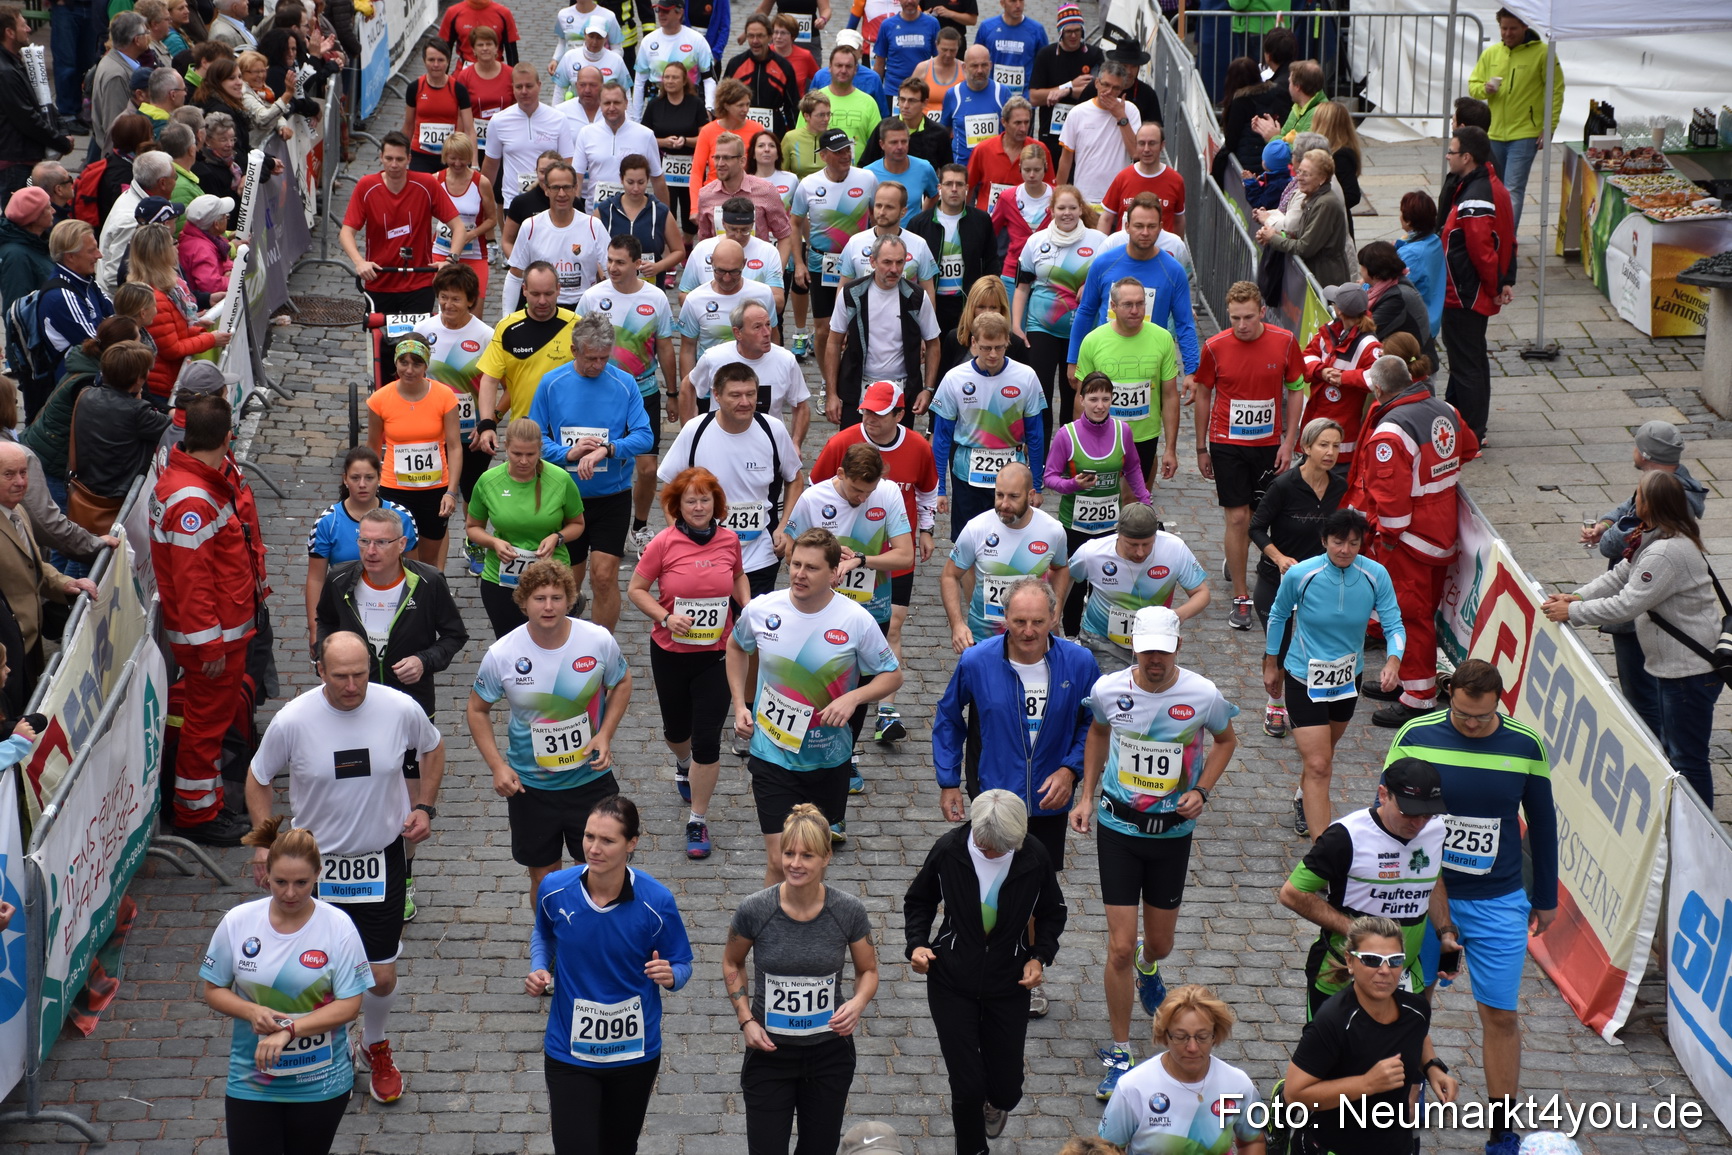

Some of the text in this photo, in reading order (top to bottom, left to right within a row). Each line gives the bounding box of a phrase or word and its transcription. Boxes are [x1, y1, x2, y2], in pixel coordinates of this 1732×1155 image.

[896, 34, 924, 43] HUBER
[995, 39, 1024, 49] HUBER
[996, 72, 1022, 86] 2318
[972, 122, 994, 135] 380
[665, 162, 692, 175] 2562
[237, 162, 257, 232] BMW Laufsport
[463, 342, 478, 350] Hervis
[512, 346, 534, 354] Robert
[1003, 388, 1019, 396] Hervis
[1110, 389, 1146, 407] 2341
[1115, 409, 1143, 417] Wolfgang
[1234, 409, 1272, 425] 2049
[1241, 427, 1264, 435] Bastian
[404, 453, 433, 471] 164
[407, 473, 432, 482] Claudia
[867, 510, 885, 518] Hervis
[1079, 504, 1116, 521] 2295
[1031, 543, 1048, 552] Hervis
[1150, 568, 1168, 577] Hervis
[685, 608, 718, 627] 328
[684, 630, 715, 639] Susanne
[827, 631, 847, 642] Hervis
[574, 658, 595, 668] Hervis
[1313, 664, 1352, 686] 2428
[763, 685, 803, 715] PARTL Neumarkt
[1026, 696, 1048, 717] 87
[765, 700, 796, 731] 211
[1172, 707, 1192, 717] Hervis
[533, 723, 581, 734] PARTL Neumarkt
[767, 724, 782, 741] Jörg
[809, 729, 824, 739] 16.
[544, 729, 582, 753] 319
[1120, 740, 1172, 754] PARTL Neumarkt
[558, 755, 575, 765] Rolf
[1131, 753, 1169, 776] 119
[1132, 776, 1164, 790] Thomas
[1161, 799, 1174, 808] 16.
[1459, 821, 1490, 831] Neumarkt
[1444, 826, 1494, 853] 2253
[1448, 853, 1478, 866] Harald
[324, 857, 379, 881] 2080
[331, 885, 372, 898] Wolfgang
[1370, 887, 1434, 901] Laufteam
[1380, 901, 1419, 915] Fürth
[238, 959, 258, 968] PARTL
[303, 953, 326, 964] Hervis
[237, 965, 258, 973] Neumarkt
[767, 978, 825, 988] PARTL Neumarkt
[773, 988, 829, 1012] 2516
[575, 1004, 631, 1017] PARTL Neumarkt
[580, 1014, 638, 1041] 2096
[789, 1017, 812, 1029] Katja
[590, 1043, 626, 1056] Kristina
[276, 1054, 317, 1069] Caroline
